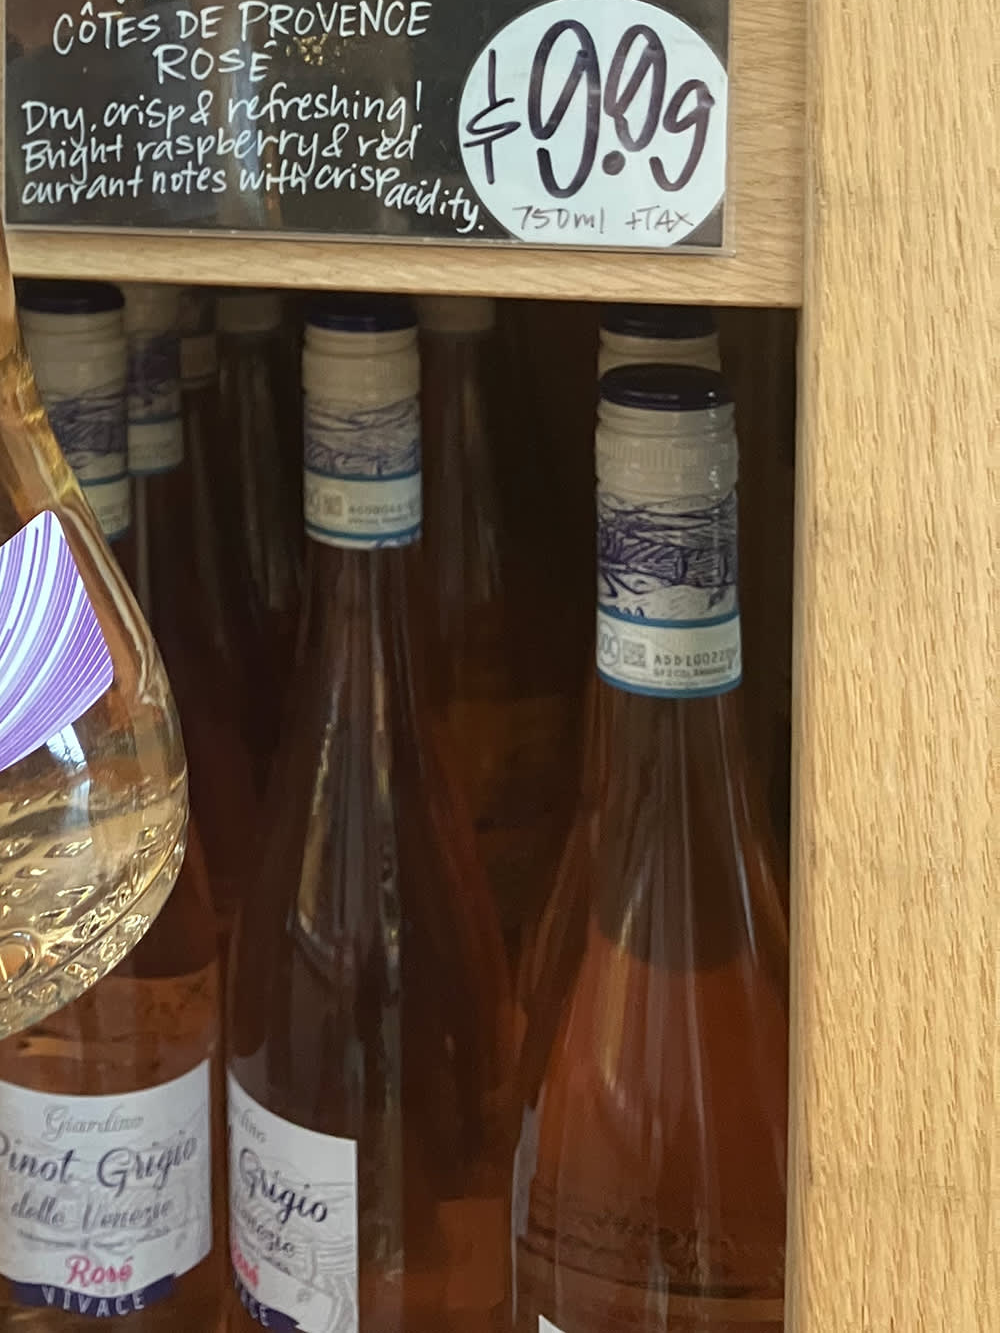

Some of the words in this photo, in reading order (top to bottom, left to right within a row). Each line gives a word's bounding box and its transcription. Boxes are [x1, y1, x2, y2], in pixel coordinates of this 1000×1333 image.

[52, 1, 161, 56] CÔTES
[175, 4, 225, 41] DE
[102, 93, 187, 138] crisp
[188, 90, 214, 126] &
[227, 79, 423, 142] refreshing!
[21, 132, 124, 185] Bright
[135, 127, 319, 180] raspberry
[320, 123, 350, 160] &
[358, 123, 423, 162] red
[20, 164, 144, 206] currant
[151, 162, 228, 196] notes
[238, 158, 308, 196] with
[312, 162, 400, 198] crisp
[512, 206, 606, 235] 750ml
[94, 1129, 198, 1198] Grigio
[65, 1253, 135, 1289] Rosé
[41, 1286, 145, 1318] VIVACE
